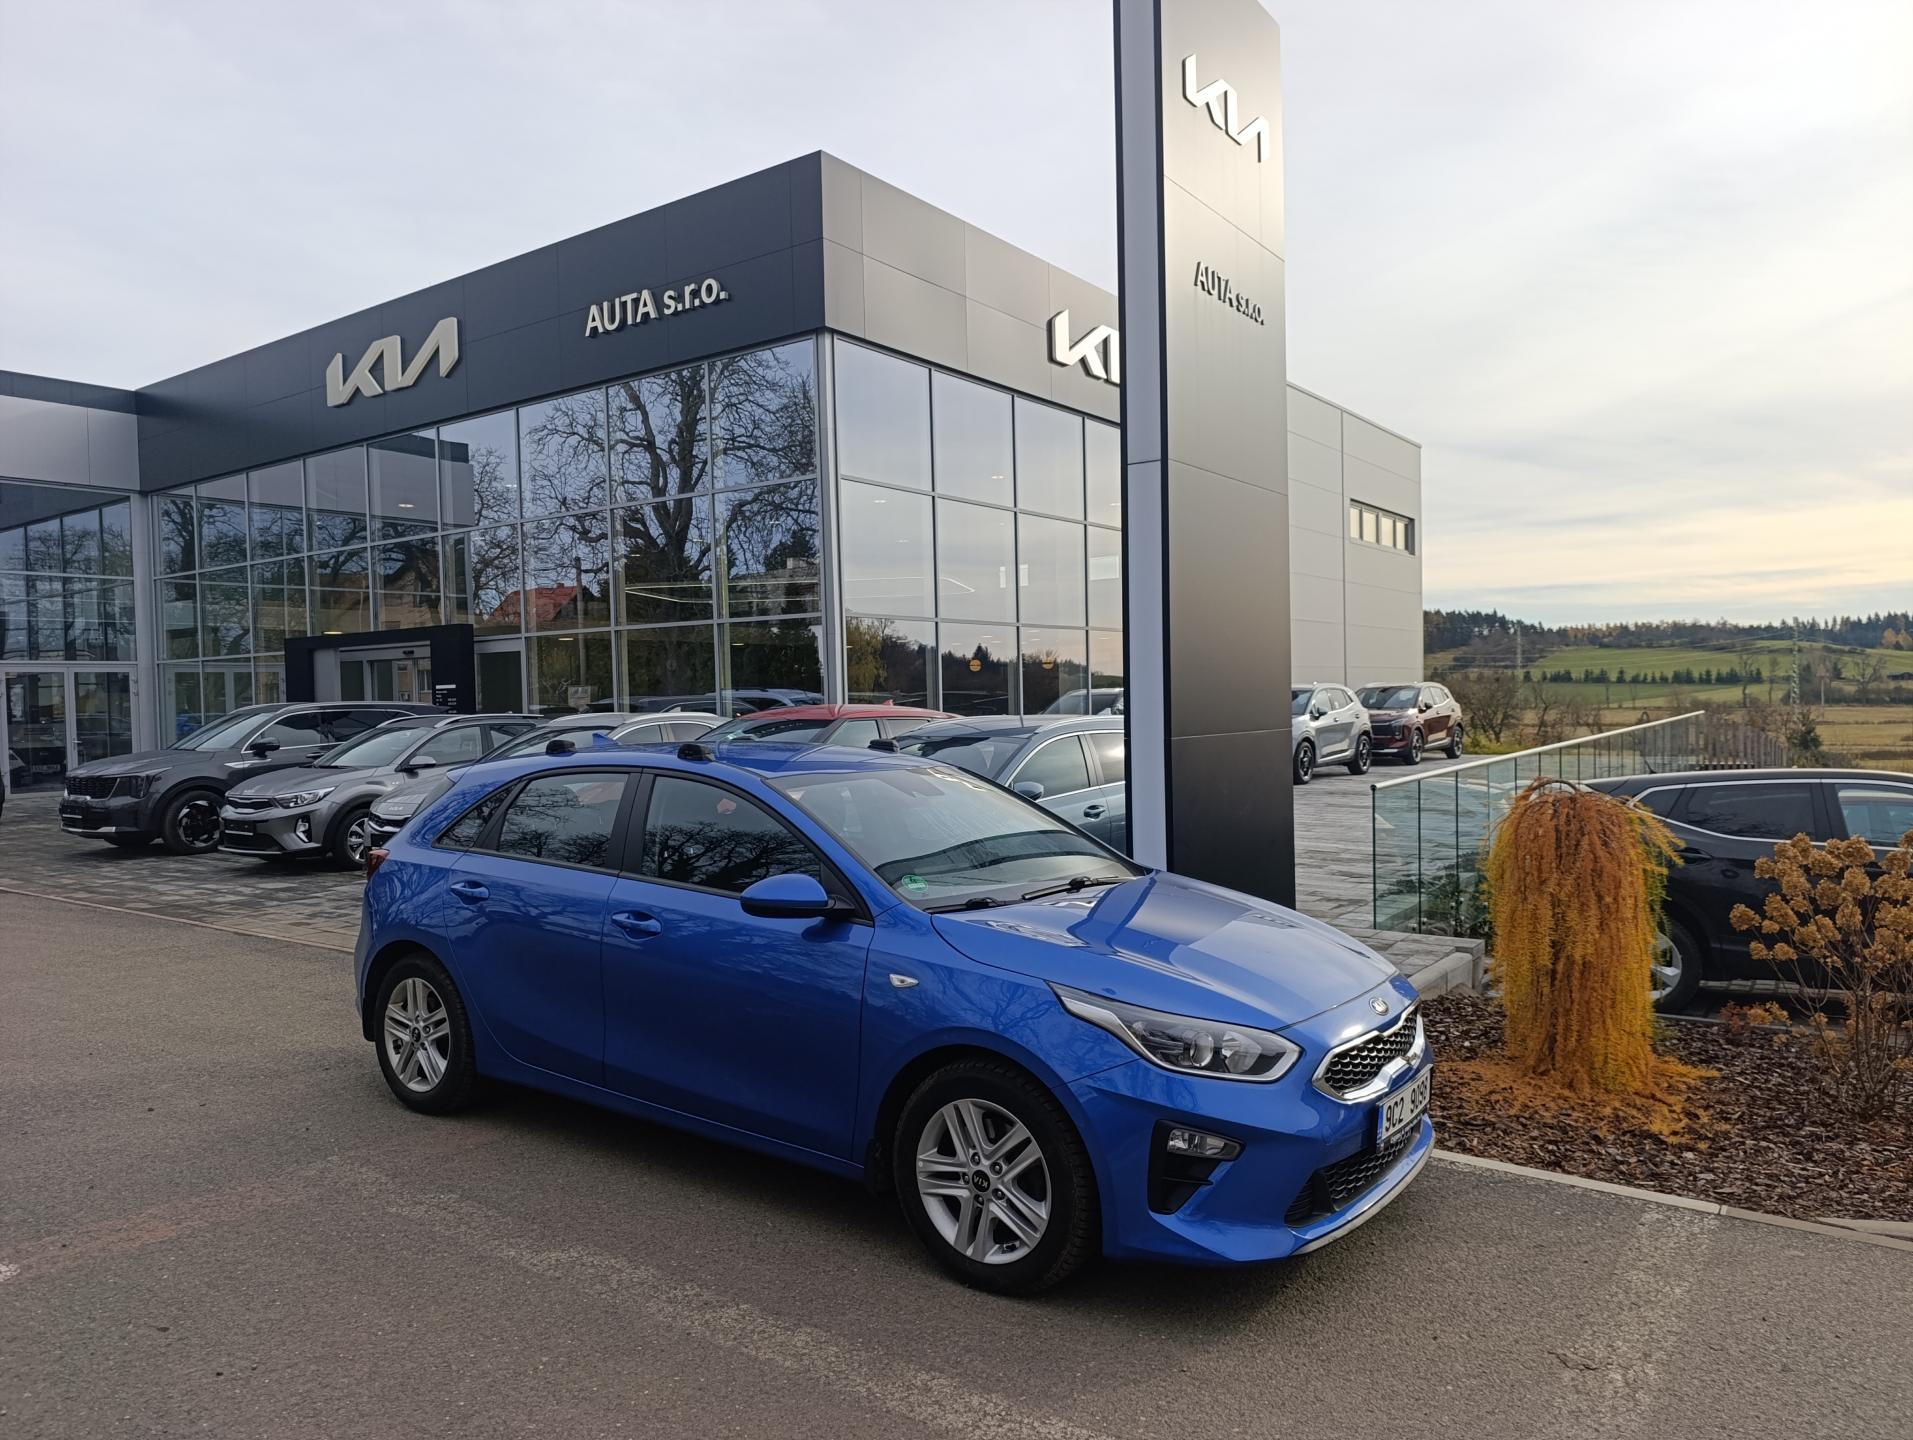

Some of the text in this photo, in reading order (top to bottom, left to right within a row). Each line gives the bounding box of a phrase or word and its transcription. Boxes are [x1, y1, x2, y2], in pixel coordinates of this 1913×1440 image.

[1182, 54, 1270, 163] KIA
[585, 278, 729, 337] AUTA s.r.o.
[1194, 261, 1264, 326] AUTA s.r.o.
[326, 316, 459, 407] KIA
[1047, 309, 1120, 388] KI
[1384, 1096, 1405, 1132] 9C2
